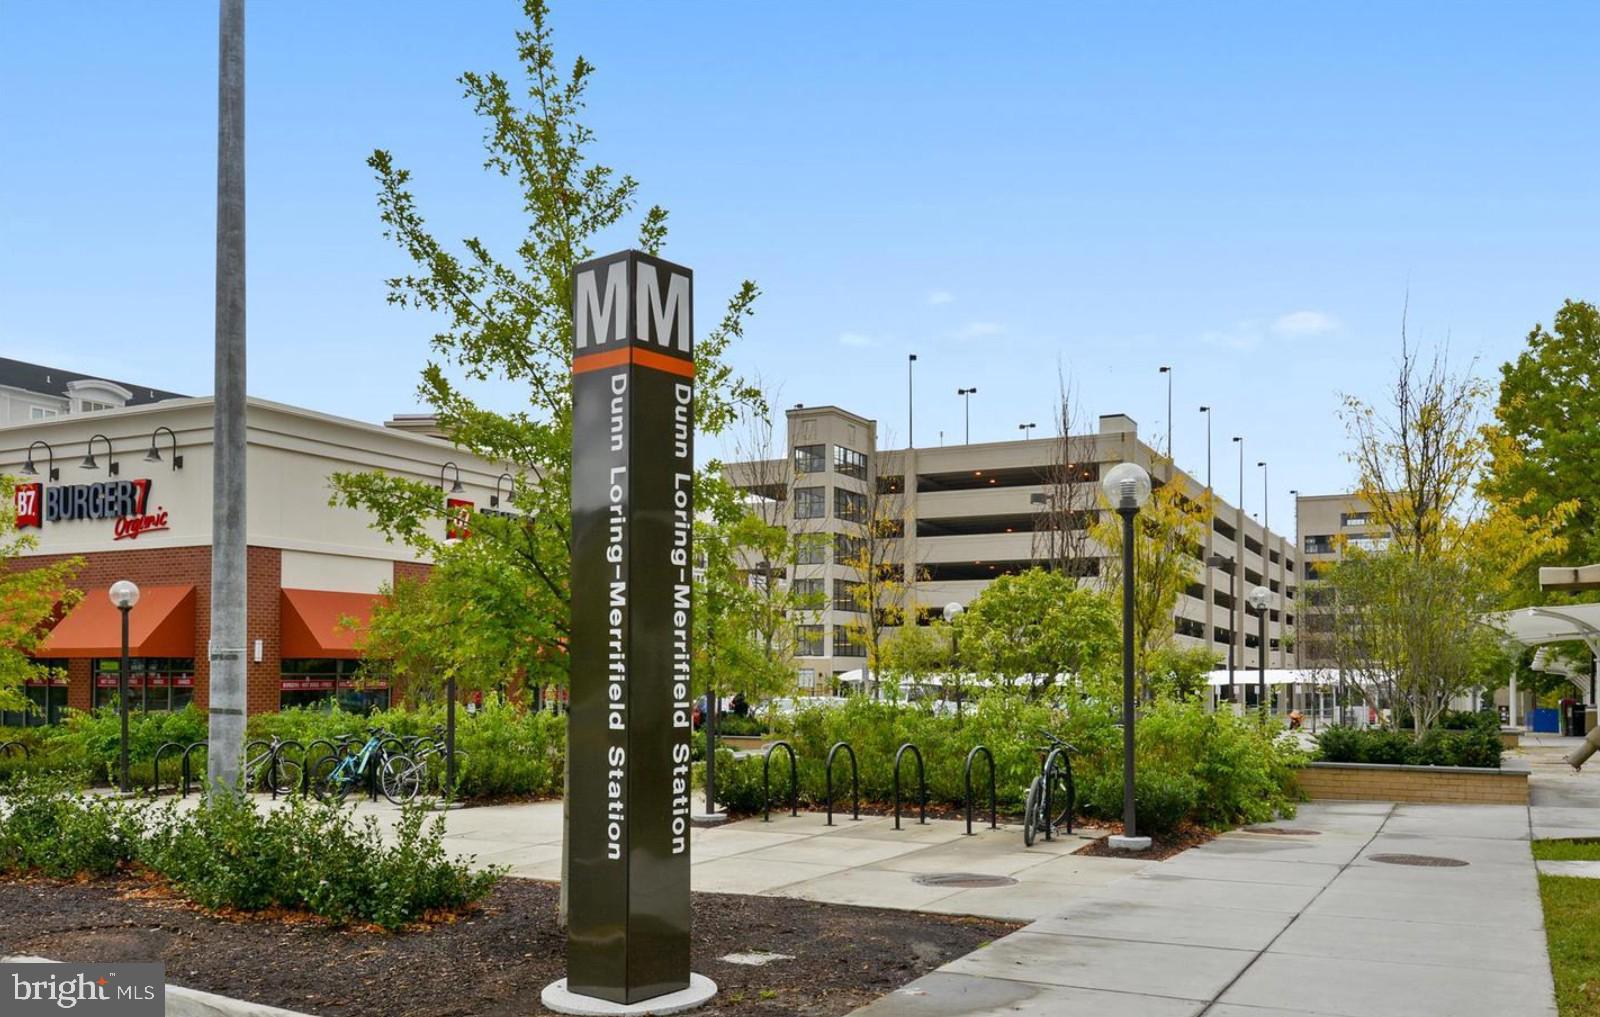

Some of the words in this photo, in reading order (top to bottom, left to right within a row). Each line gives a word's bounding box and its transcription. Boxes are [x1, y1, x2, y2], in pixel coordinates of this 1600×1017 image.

[576, 260, 627, 350] M
[636, 260, 690, 352] M
[610, 374, 627, 451] Dunn
[675, 383, 692, 458] Dunn
[113, 506, 170, 540] Organic
[607, 466, 627, 730] Loring-Merrifield
[671, 472, 691, 728] Loring-Merrifield
[608, 745, 626, 861] Station
[672, 743, 690, 854] Station
